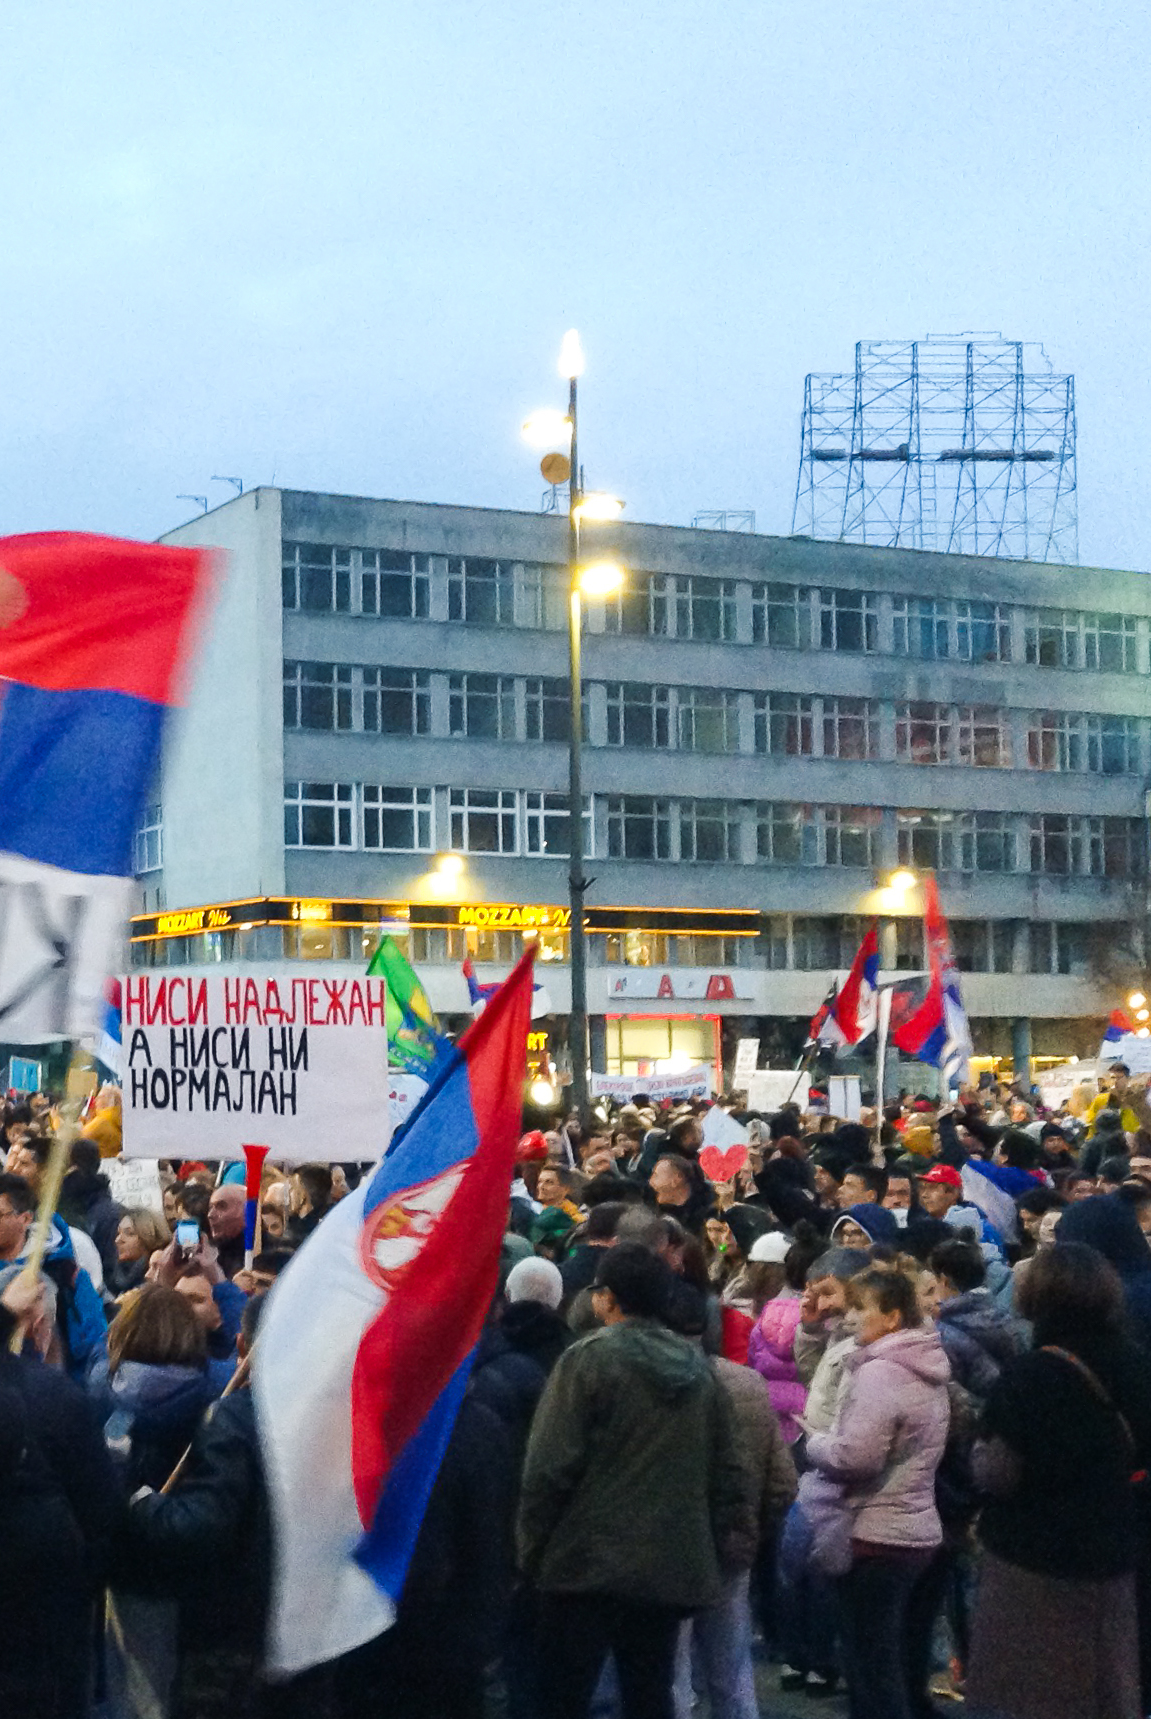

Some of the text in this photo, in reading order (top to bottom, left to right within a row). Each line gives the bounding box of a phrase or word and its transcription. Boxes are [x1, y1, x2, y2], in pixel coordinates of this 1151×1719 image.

[158, 911, 205, 934] MOZZART
[459, 906, 546, 926] MOZZART
[126, 976, 385, 1027] НИСИ НАДЛЕЖАН
[128, 1027, 308, 1071] А НИСИ НИ
[132, 1068, 297, 1115] НОРМАЛАН
